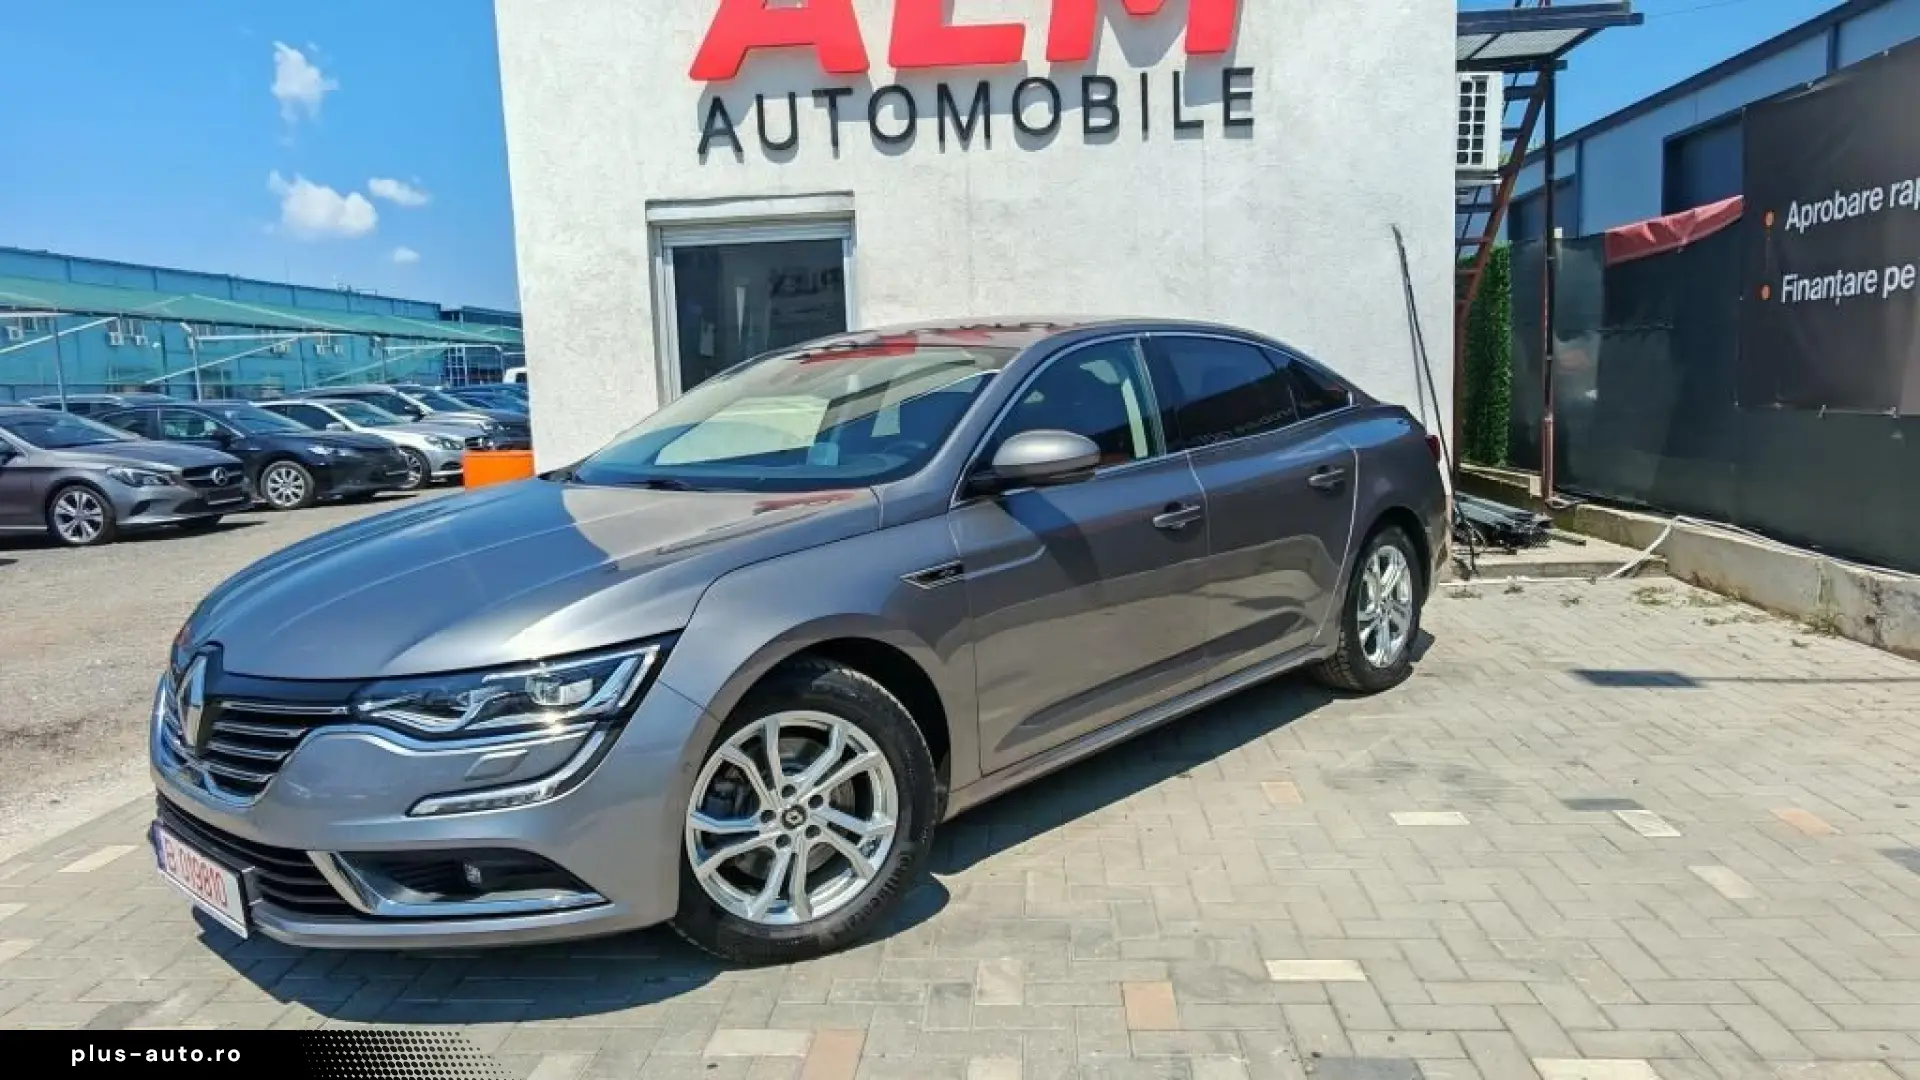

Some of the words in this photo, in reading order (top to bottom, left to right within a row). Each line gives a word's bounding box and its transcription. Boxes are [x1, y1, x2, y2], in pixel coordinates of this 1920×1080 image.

[698, 67, 1255, 154] AUTOMOBILE
[1784, 186, 1884, 234] Aprobare
[1781, 269, 1878, 305] Finanțare
[1882, 263, 1916, 299] pe
